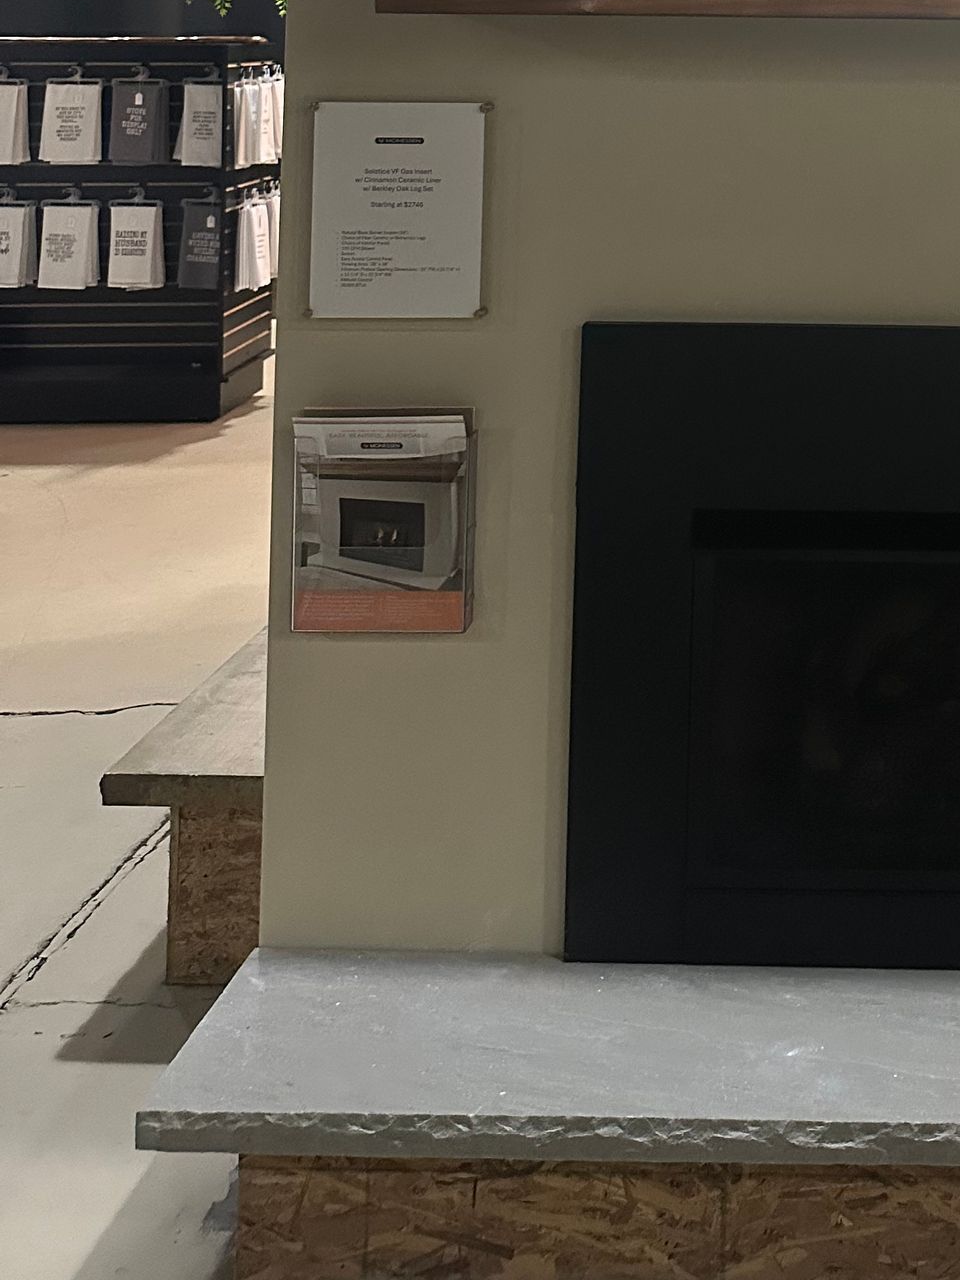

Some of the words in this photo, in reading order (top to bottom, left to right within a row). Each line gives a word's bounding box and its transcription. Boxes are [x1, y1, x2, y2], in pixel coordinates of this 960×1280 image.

[410, 185, 422, 193] Log
[370, 201, 396, 209] Starting
[115, 239, 148, 248] HUSBAND
